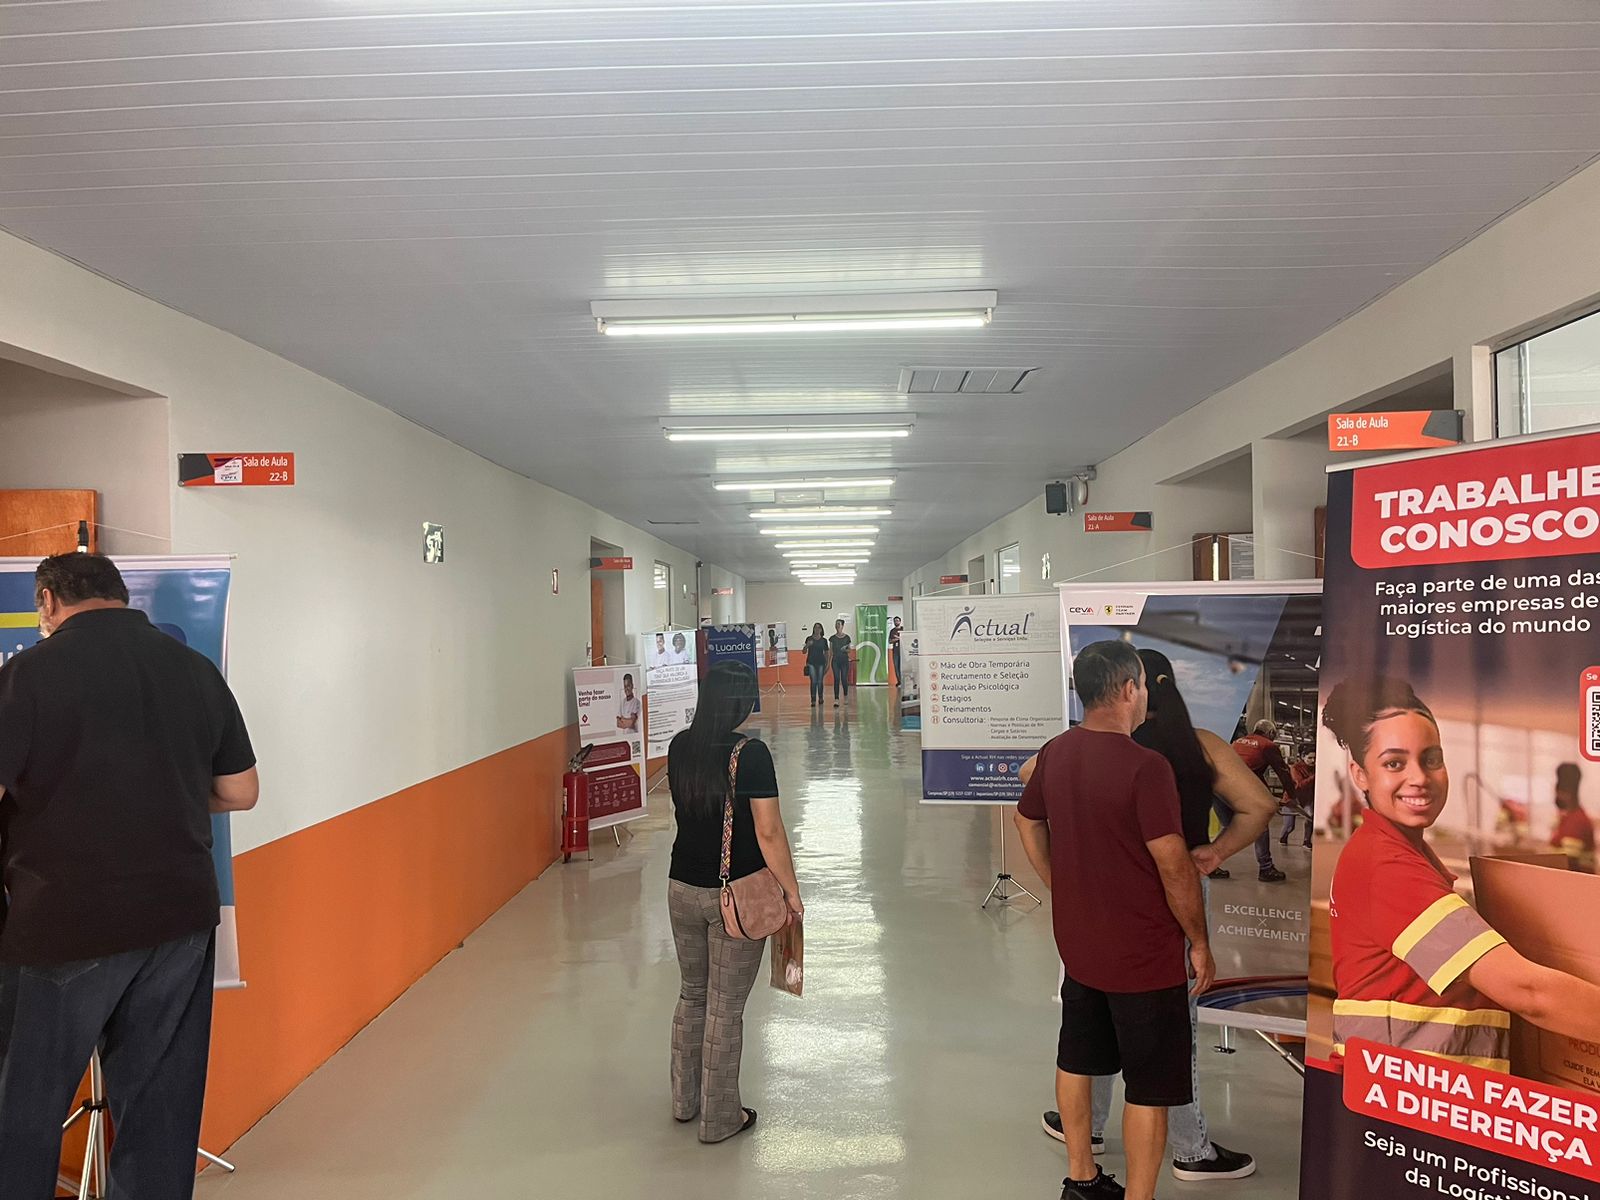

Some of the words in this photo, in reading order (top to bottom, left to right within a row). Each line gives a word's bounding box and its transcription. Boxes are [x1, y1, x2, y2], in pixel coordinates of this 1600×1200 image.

[1336, 417, 1354, 430] Sala
[1356, 416, 1367, 428] de
[1369, 416, 1388, 428] Aula
[1336, 434, 1358, 446] 21-B
[244, 456, 258, 467] Sala
[260, 456, 270, 466] de
[271, 456, 288, 466] Aula
[269, 472, 288, 482] 22-B
[1374, 465, 1600, 518] TRABALHE
[1380, 506, 1600, 554] CONOSCO
[1375, 581, 1416, 598] Faça
[1423, 578, 1475, 597] parte
[1481, 574, 1508, 590] de
[1513, 574, 1560, 588] uma
[1567, 569, 1600, 586] das
[1380, 599, 1456, 616] maiores
[1461, 596, 1565, 615] empresas
[1571, 592, 1599, 609] de
[1386, 619, 1472, 639] Logística
[1478, 618, 1506, 634] do
[1512, 616, 1591, 633] mundo
[716, 642, 751, 652] Luandre
[989, 661, 1030, 669] Temporária
[941, 672, 992, 680] Recrutamento
[1000, 672, 1029, 680] Seleção
[942, 684, 976, 692] Avaliação
[978, 683, 1019, 692] Psicológica
[943, 716, 986, 724] Consultoria:
[1224, 904, 1302, 920] EXCELLENCE
[1217, 925, 1306, 942] ACHIEVEMENT
[1361, 1049, 1475, 1100] VENHA
[1484, 1080, 1598, 1133] FAZER
[1364, 1084, 1388, 1109] A
[1397, 1090, 1593, 1166] DIFERENÇA
[1364, 1130, 1406, 1157] Seja
[1412, 1148, 1447, 1169] um
[1404, 1168, 1430, 1188] da
